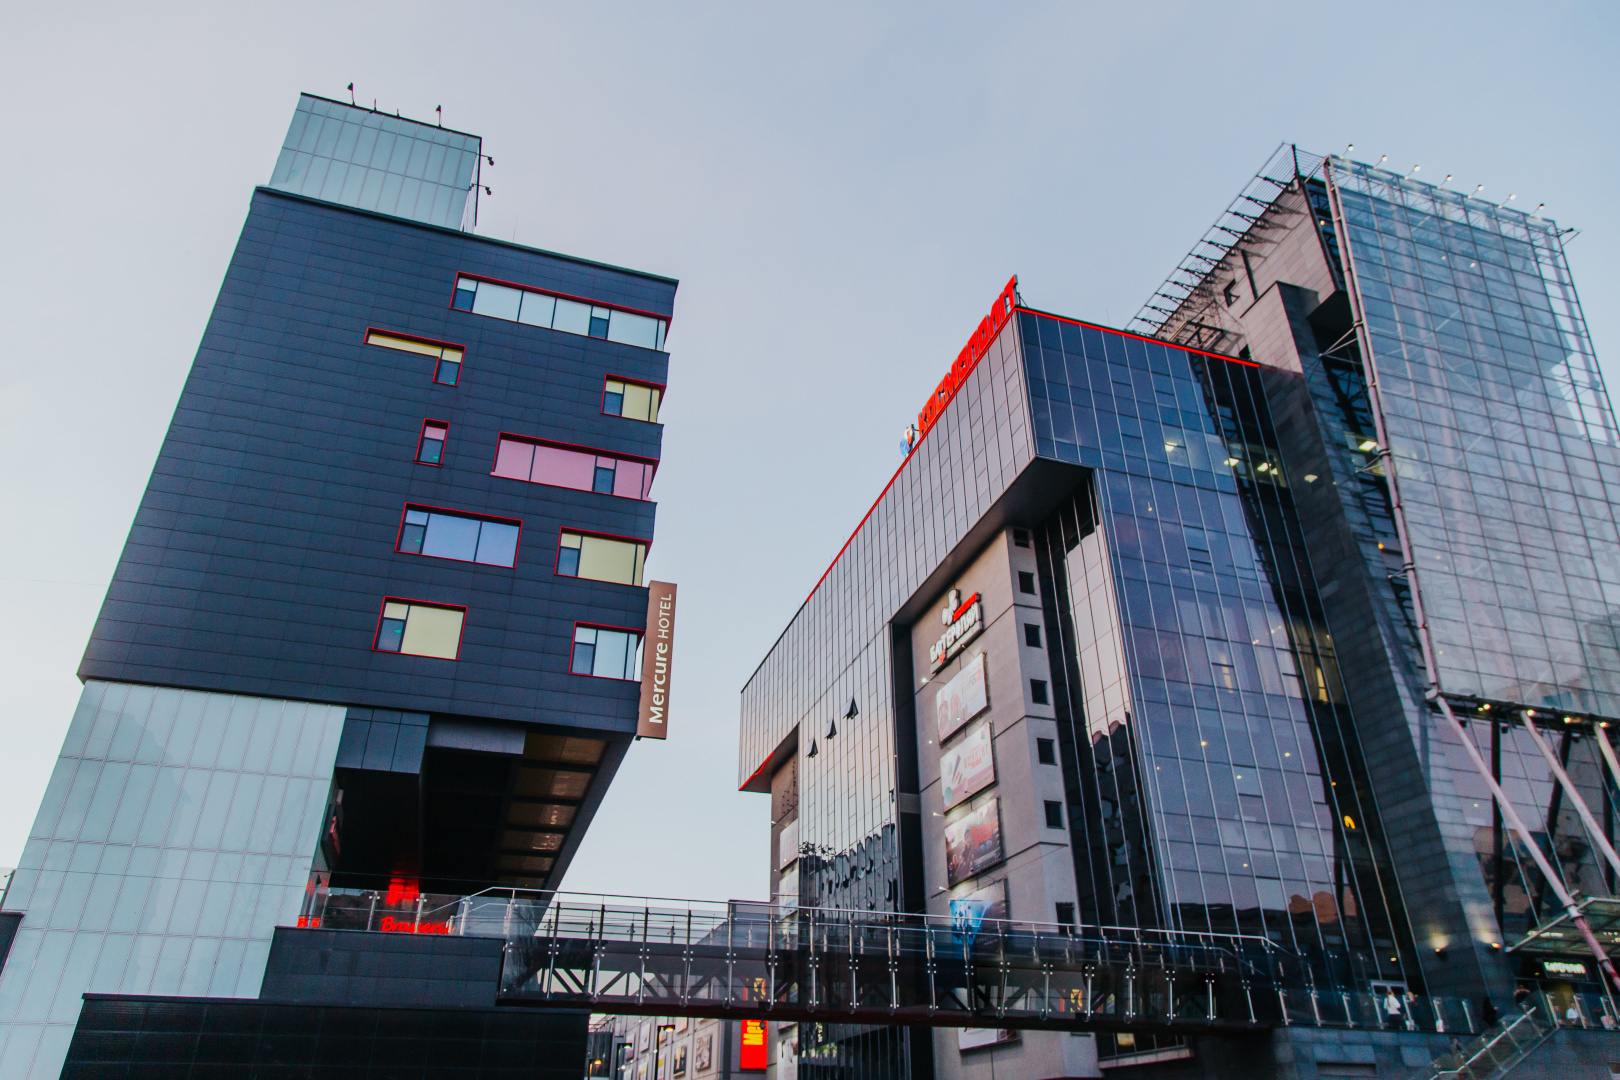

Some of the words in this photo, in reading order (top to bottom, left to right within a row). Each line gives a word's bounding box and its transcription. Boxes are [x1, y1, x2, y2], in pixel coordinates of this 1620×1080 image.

[917, 274, 1018, 438] КОСМОПОЛІТ
[657, 593, 672, 639] HOTEL
[648, 642, 669, 724] Mercure
